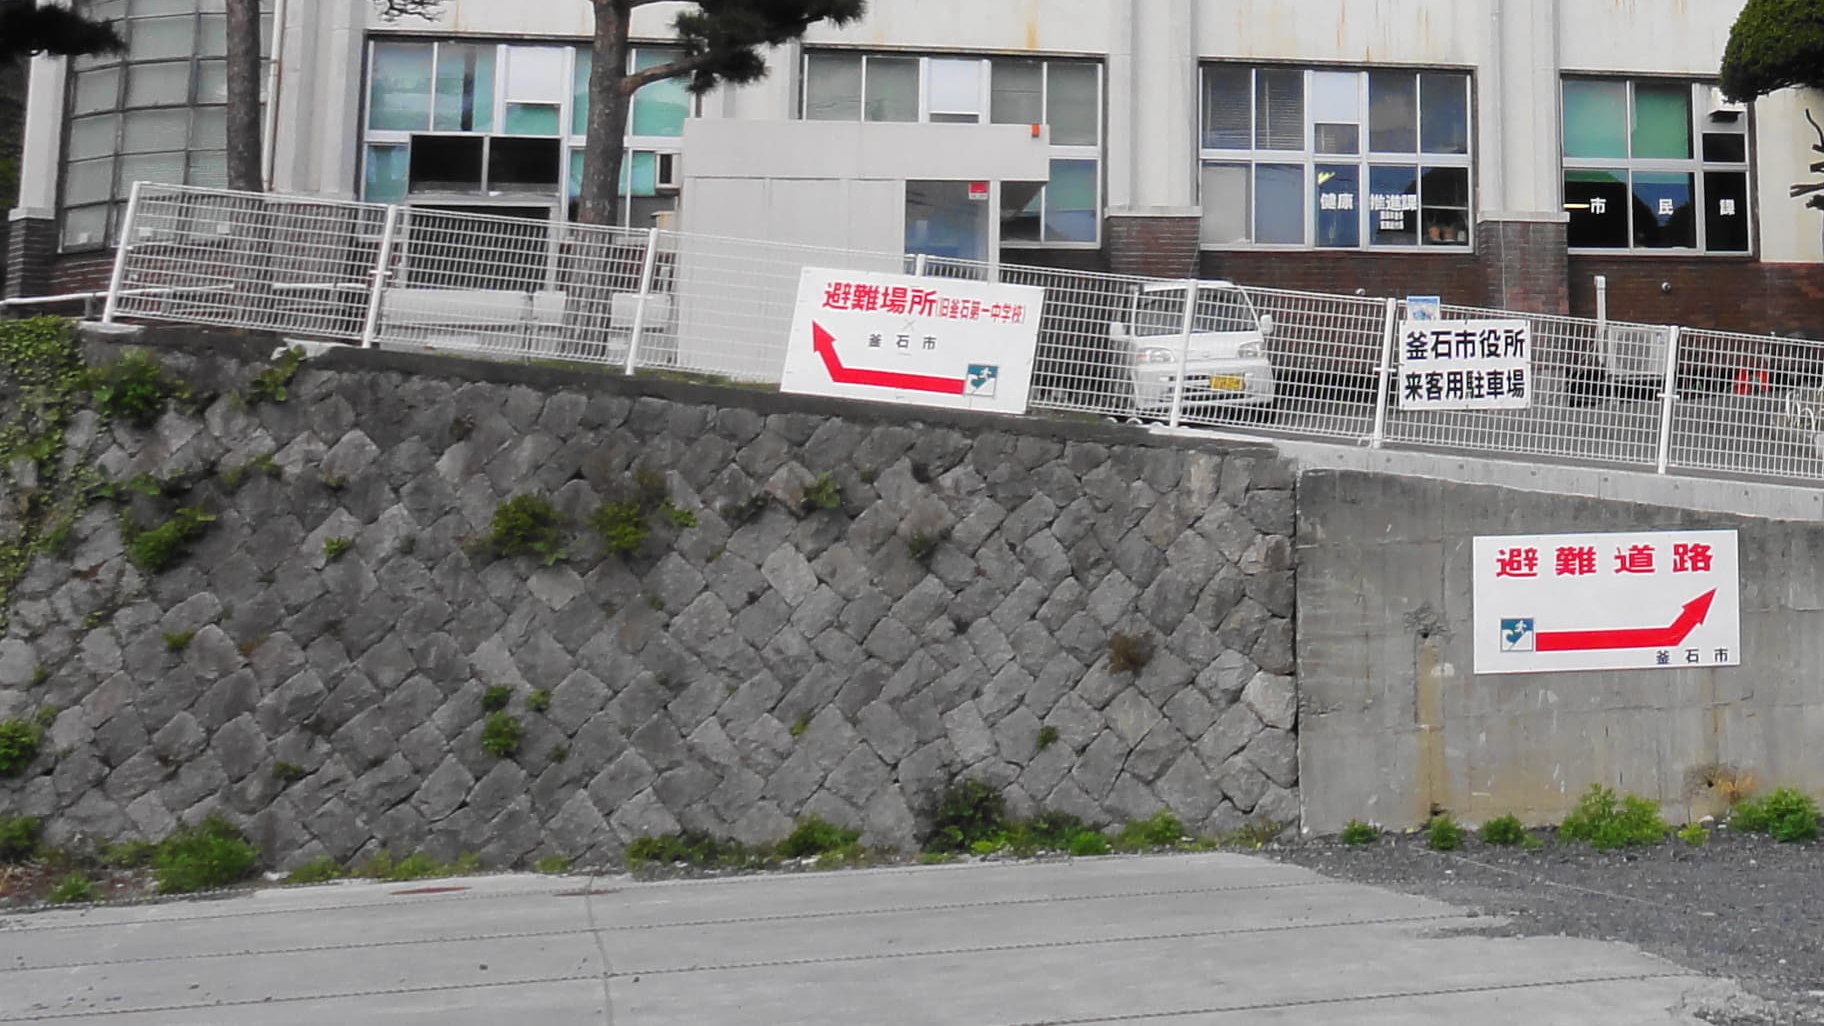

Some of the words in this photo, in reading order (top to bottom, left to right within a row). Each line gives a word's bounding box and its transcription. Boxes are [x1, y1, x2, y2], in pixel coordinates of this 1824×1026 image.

[822, 282, 937, 317] 避難場所
[1406, 329, 1525, 360] 釜石市役所
[1405, 369, 1525, 401] 来客用駐車場
[1496, 543, 1714, 577] 避難道路
